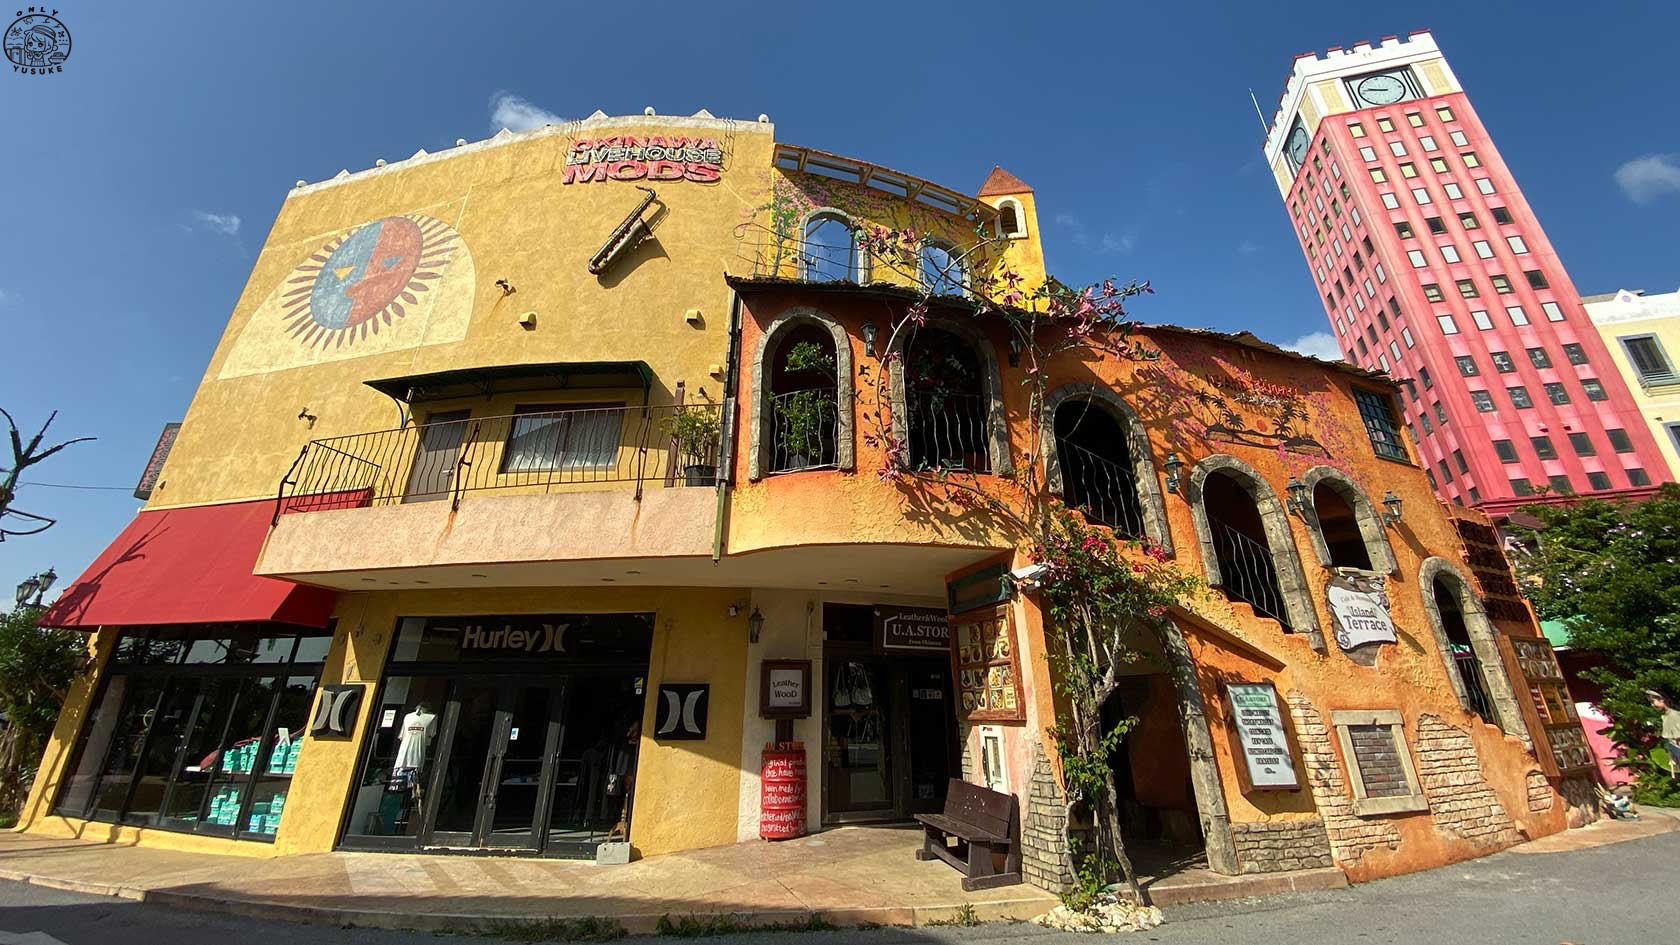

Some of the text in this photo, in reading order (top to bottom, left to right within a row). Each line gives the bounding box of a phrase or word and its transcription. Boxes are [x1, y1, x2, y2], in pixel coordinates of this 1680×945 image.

[571, 135, 720, 150] OKINAWA
[565, 146, 722, 166] LIVEHOUSE
[562, 160, 722, 184] MODS
[1343, 614, 1388, 631] Terrace
[462, 625, 540, 651] Hurley
[772, 679, 800, 688] Leather
